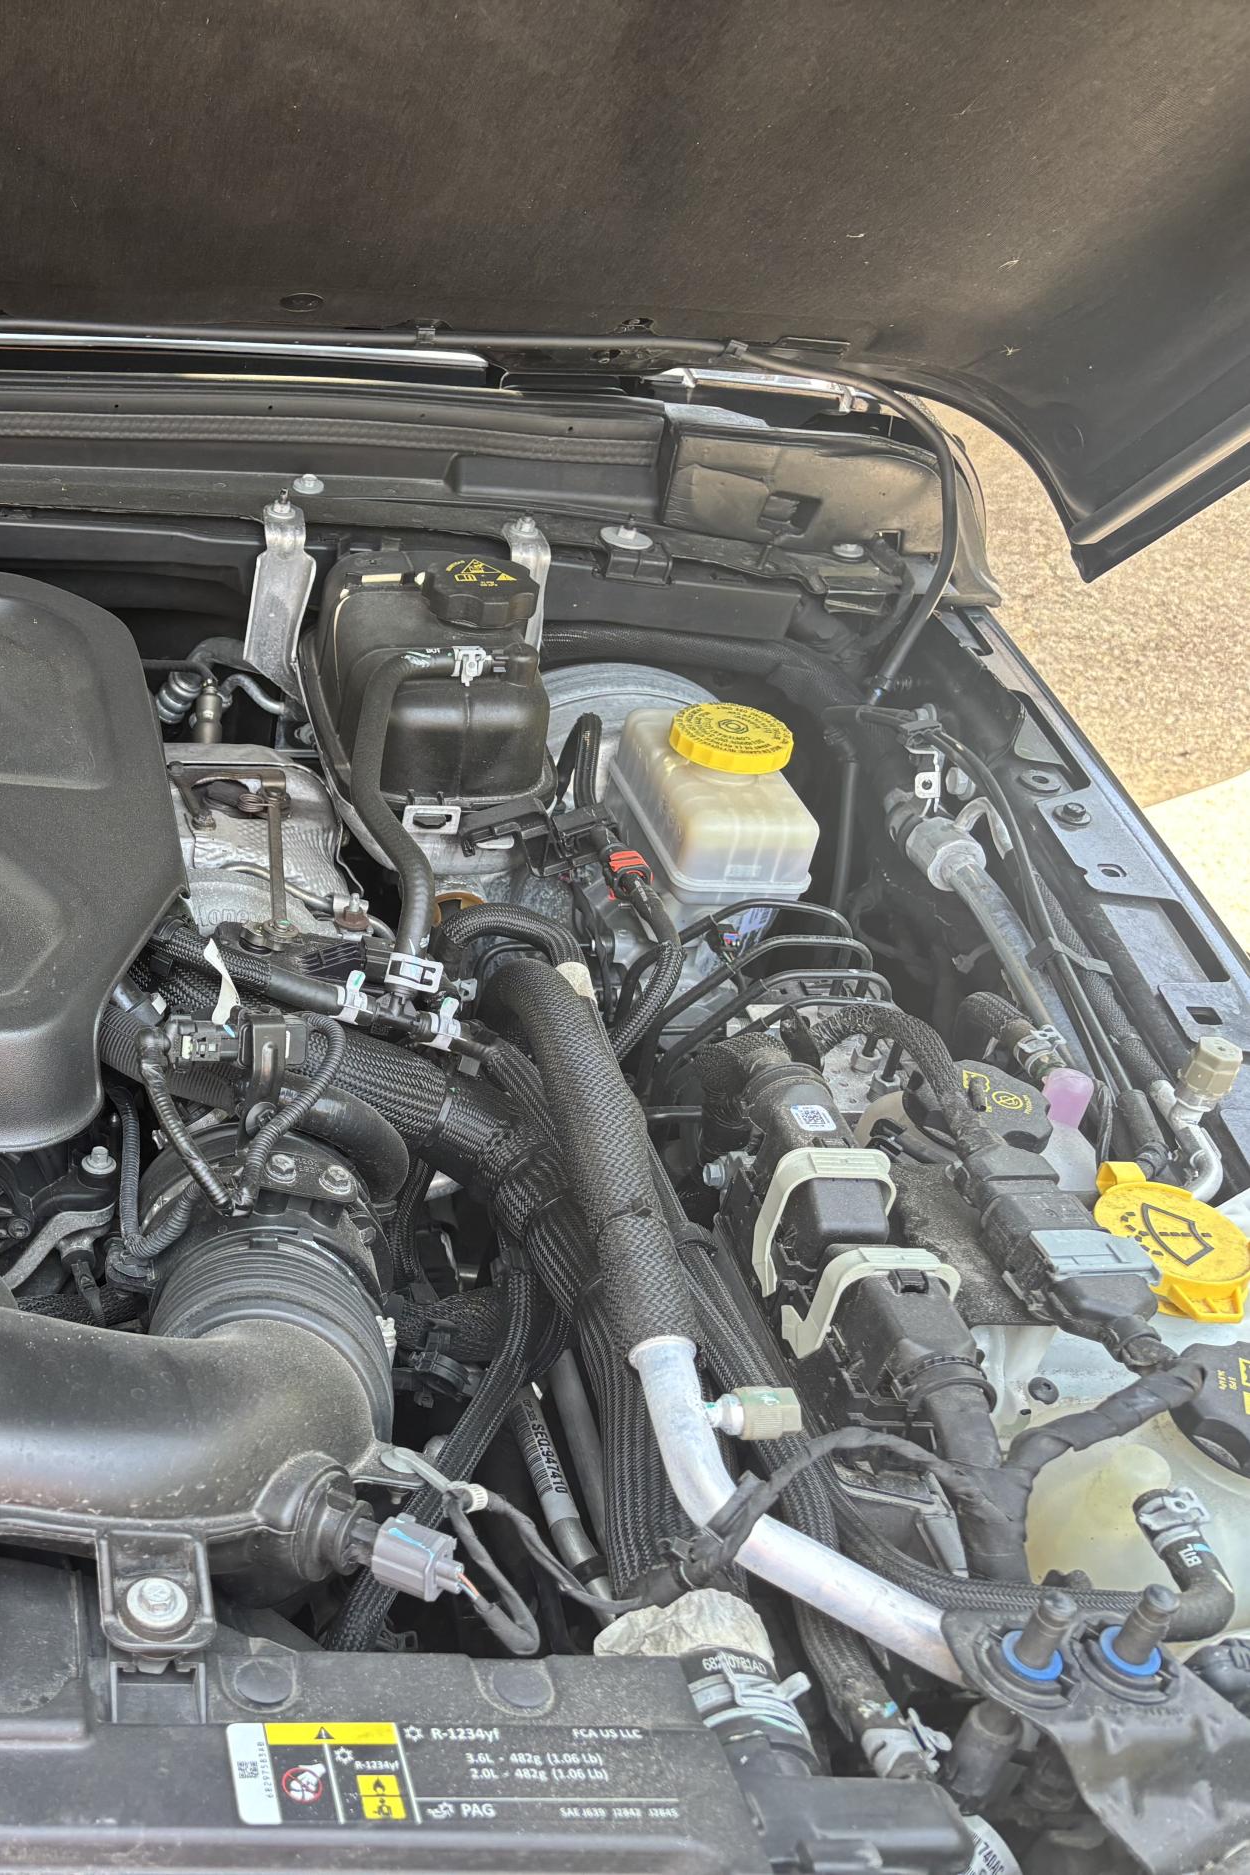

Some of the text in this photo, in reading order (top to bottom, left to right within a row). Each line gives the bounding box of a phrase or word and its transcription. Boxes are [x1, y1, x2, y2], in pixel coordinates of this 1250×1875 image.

[430, 1727, 500, 1742] R-1234yf
[572, 1728, 643, 1739] FCA US LLC
[354, 1760, 399, 1771] R-1234yf
[465, 1753, 494, 1764] 3.6L
[509, 1753, 543, 1766] 482g
[547, 1752, 579, 1765] (1.06
[469, 1768, 499, 1779] 2.0L
[514, 1768, 548, 1781] 482g
[552, 1768, 585, 1780] (1.06
[460, 1803, 496, 1817] PAG
